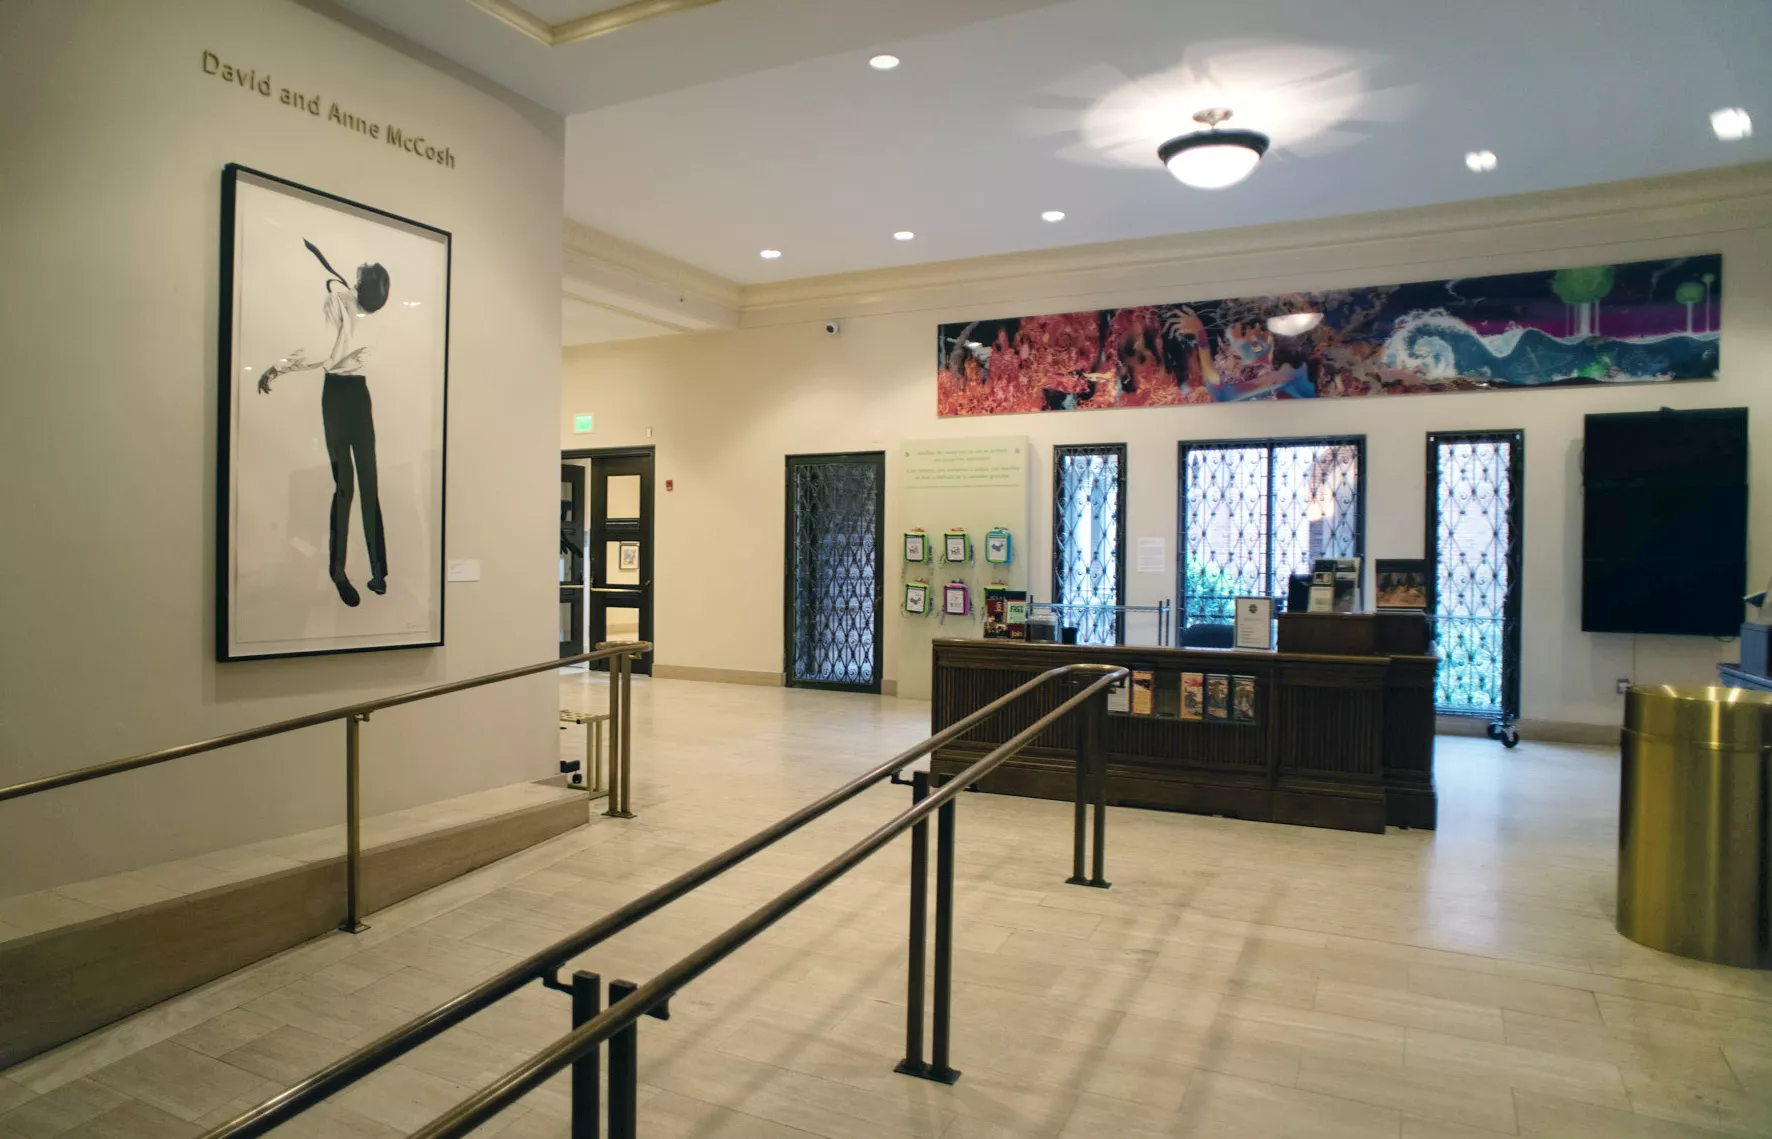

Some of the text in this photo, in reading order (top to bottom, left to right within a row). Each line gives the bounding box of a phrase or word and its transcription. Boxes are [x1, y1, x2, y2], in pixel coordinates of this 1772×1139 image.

[202, 50, 455, 169] David and Anne McCosh
[1010, 605, 1024, 613] FREE
